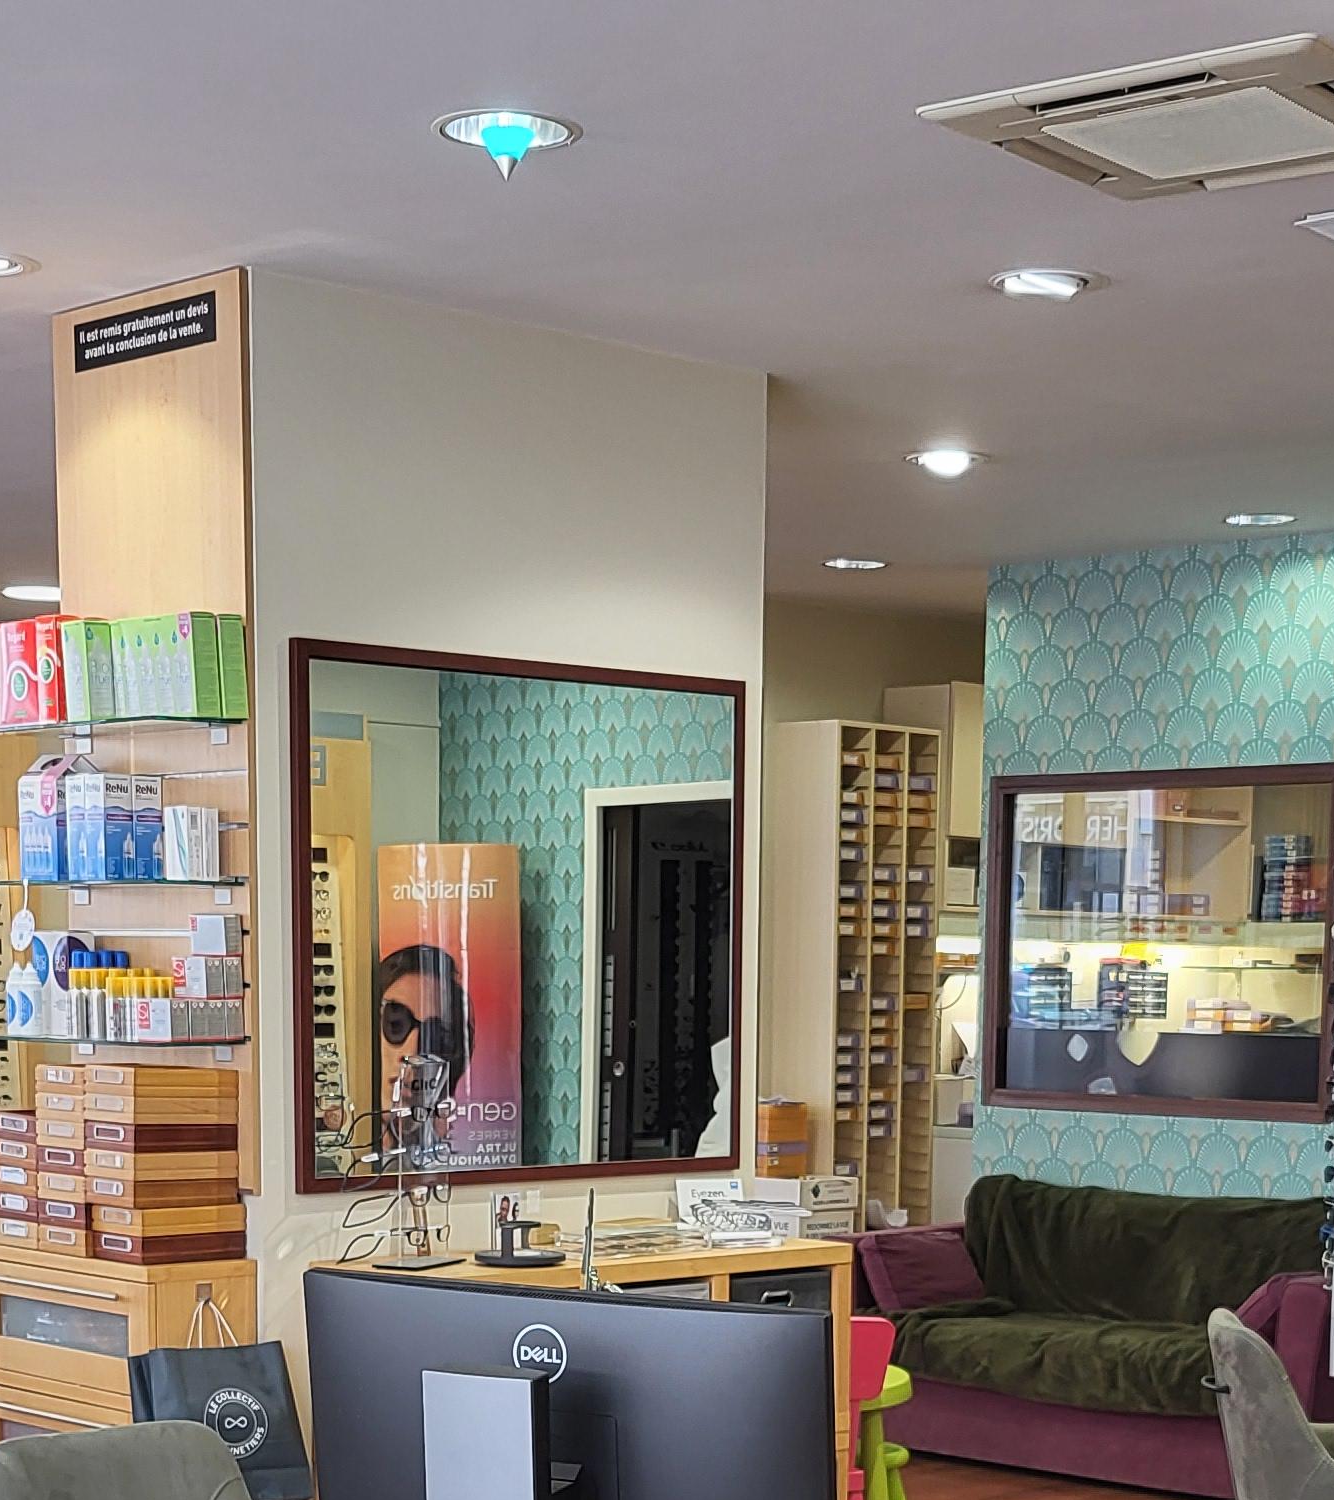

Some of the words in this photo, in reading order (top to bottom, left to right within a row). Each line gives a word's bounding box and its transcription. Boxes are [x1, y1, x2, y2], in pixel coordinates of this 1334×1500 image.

[79, 331, 85, 344] Il
[87, 331, 98, 343] est
[100, 323, 121, 338] remis
[123, 310, 174, 336] gratuitement
[175, 309, 185, 320] un
[187, 301, 209, 318] devis
[85, 343, 105, 359] avant
[107, 339, 114, 354] la
[115, 333, 156, 352] conclusion
[158, 331, 168, 342] de
[169, 328, 177, 339] la
[178, 322, 203, 337] vente.
[106, 783, 128, 794] ReNu
[136, 784, 157, 795] ReNu
[691, 1189, 725, 1200] Eyezen
[773, 1222, 789, 1230] VUE
[520, 1345, 561, 1364] DELL
[208, 1401, 218, 1414] LE
[215, 1391, 260, 1411] COLLECTIF
[230, 1426, 264, 1455] NETIERS
